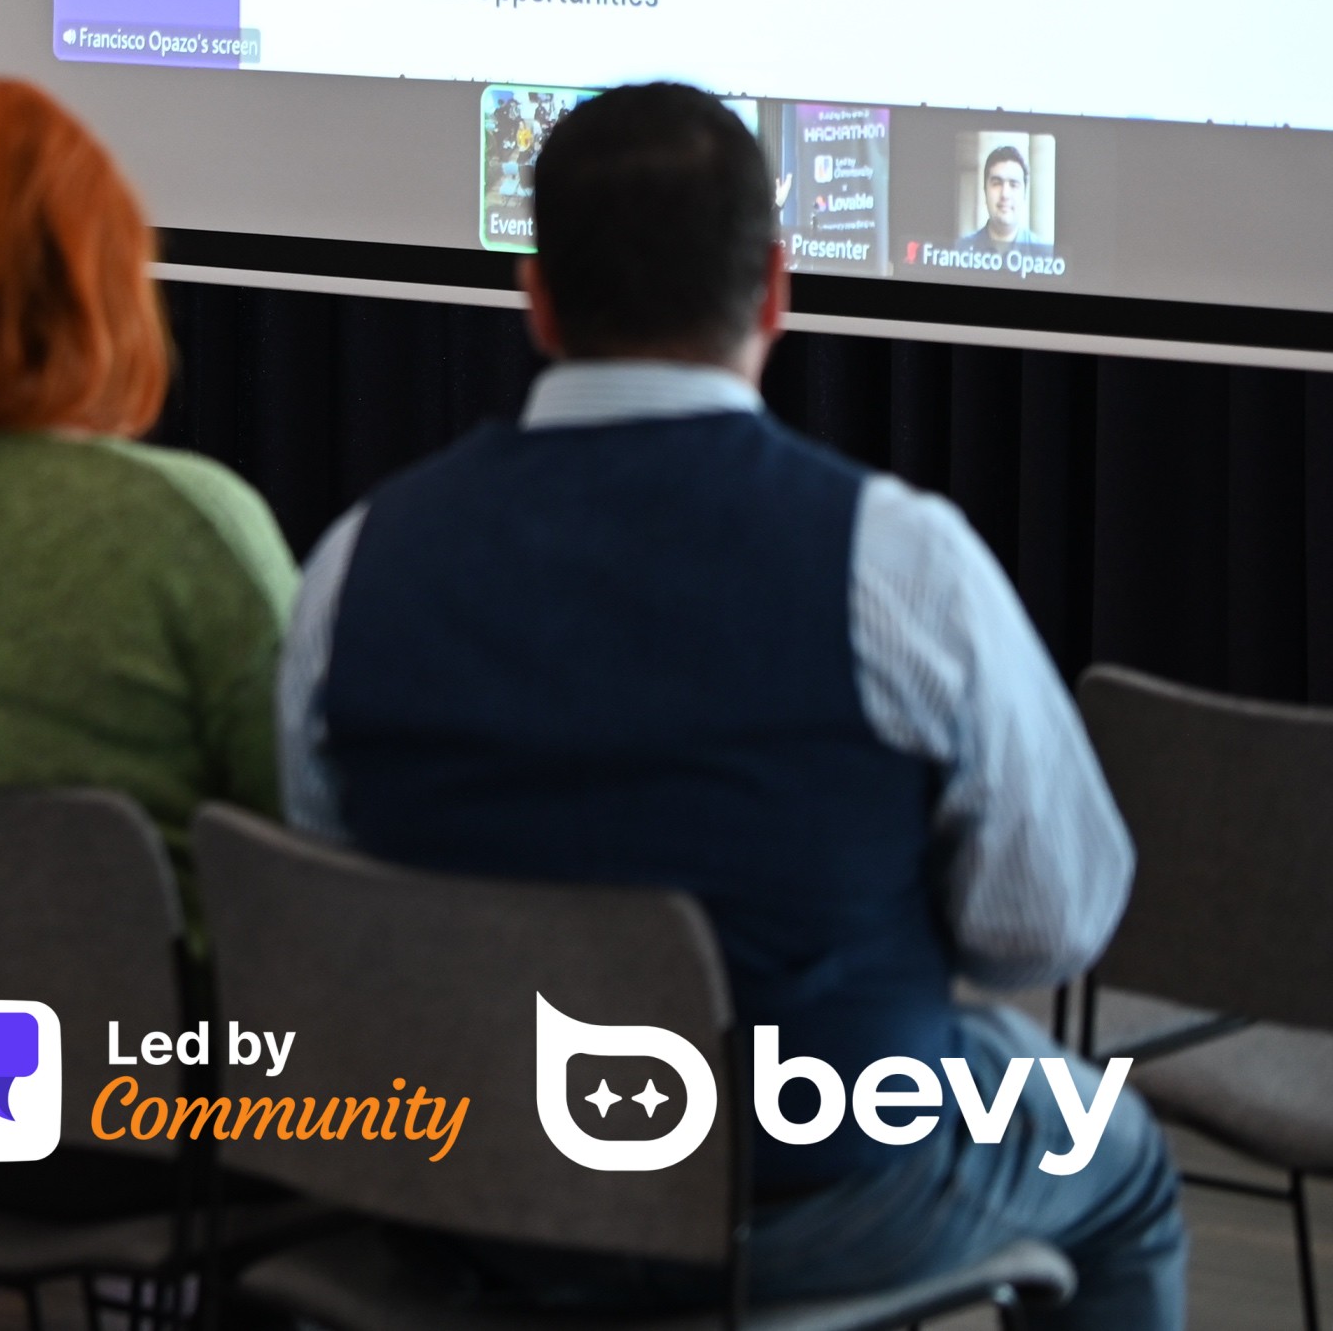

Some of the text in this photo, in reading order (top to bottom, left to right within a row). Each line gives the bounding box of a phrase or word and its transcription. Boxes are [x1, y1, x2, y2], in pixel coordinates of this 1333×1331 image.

[80, 27, 258, 57] Francisco Opazo's screen
[804, 124, 885, 142] HACKATHON
[828, 193, 874, 212] Lovable
[792, 233, 869, 260] Presenter
[923, 244, 1066, 279] Francisco Opazo
